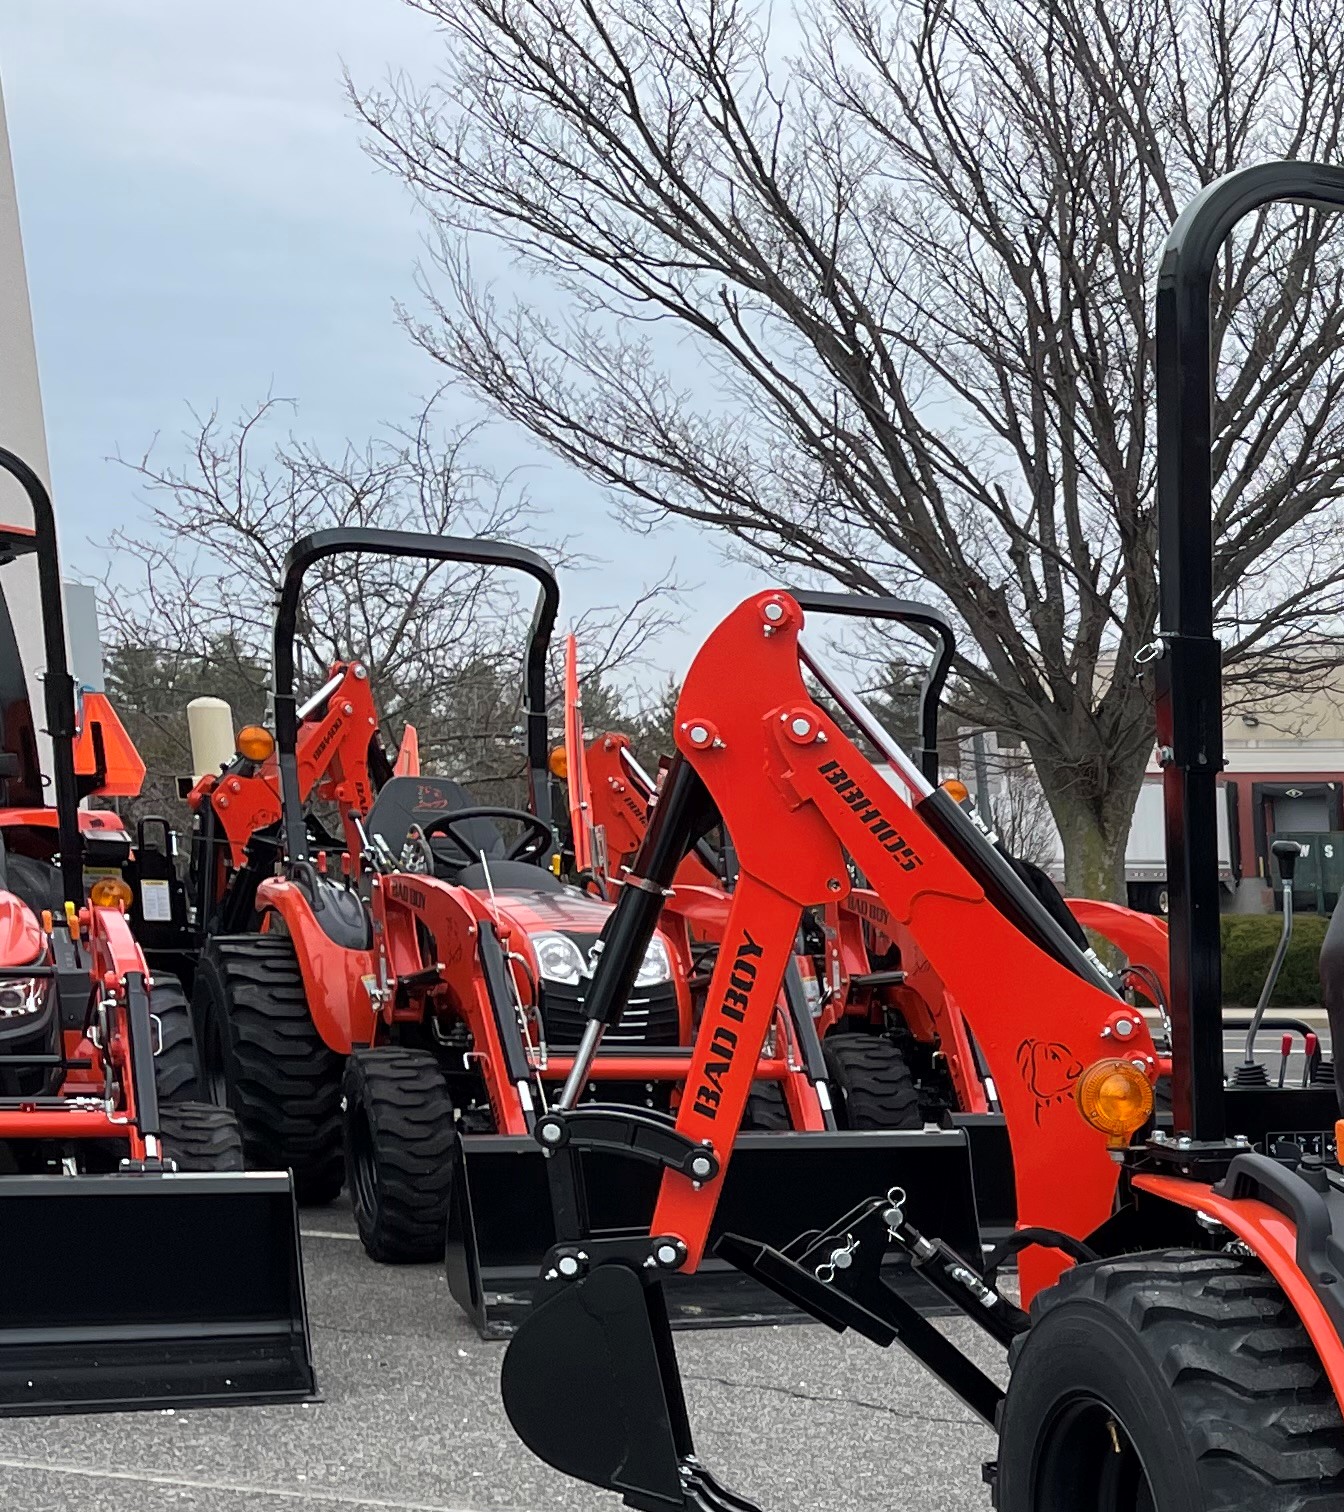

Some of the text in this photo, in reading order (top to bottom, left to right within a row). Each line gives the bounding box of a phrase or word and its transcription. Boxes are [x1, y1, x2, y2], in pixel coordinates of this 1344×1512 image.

[817, 760, 923, 872] BBH105
[692, 928, 765, 1121] BAD BOY
